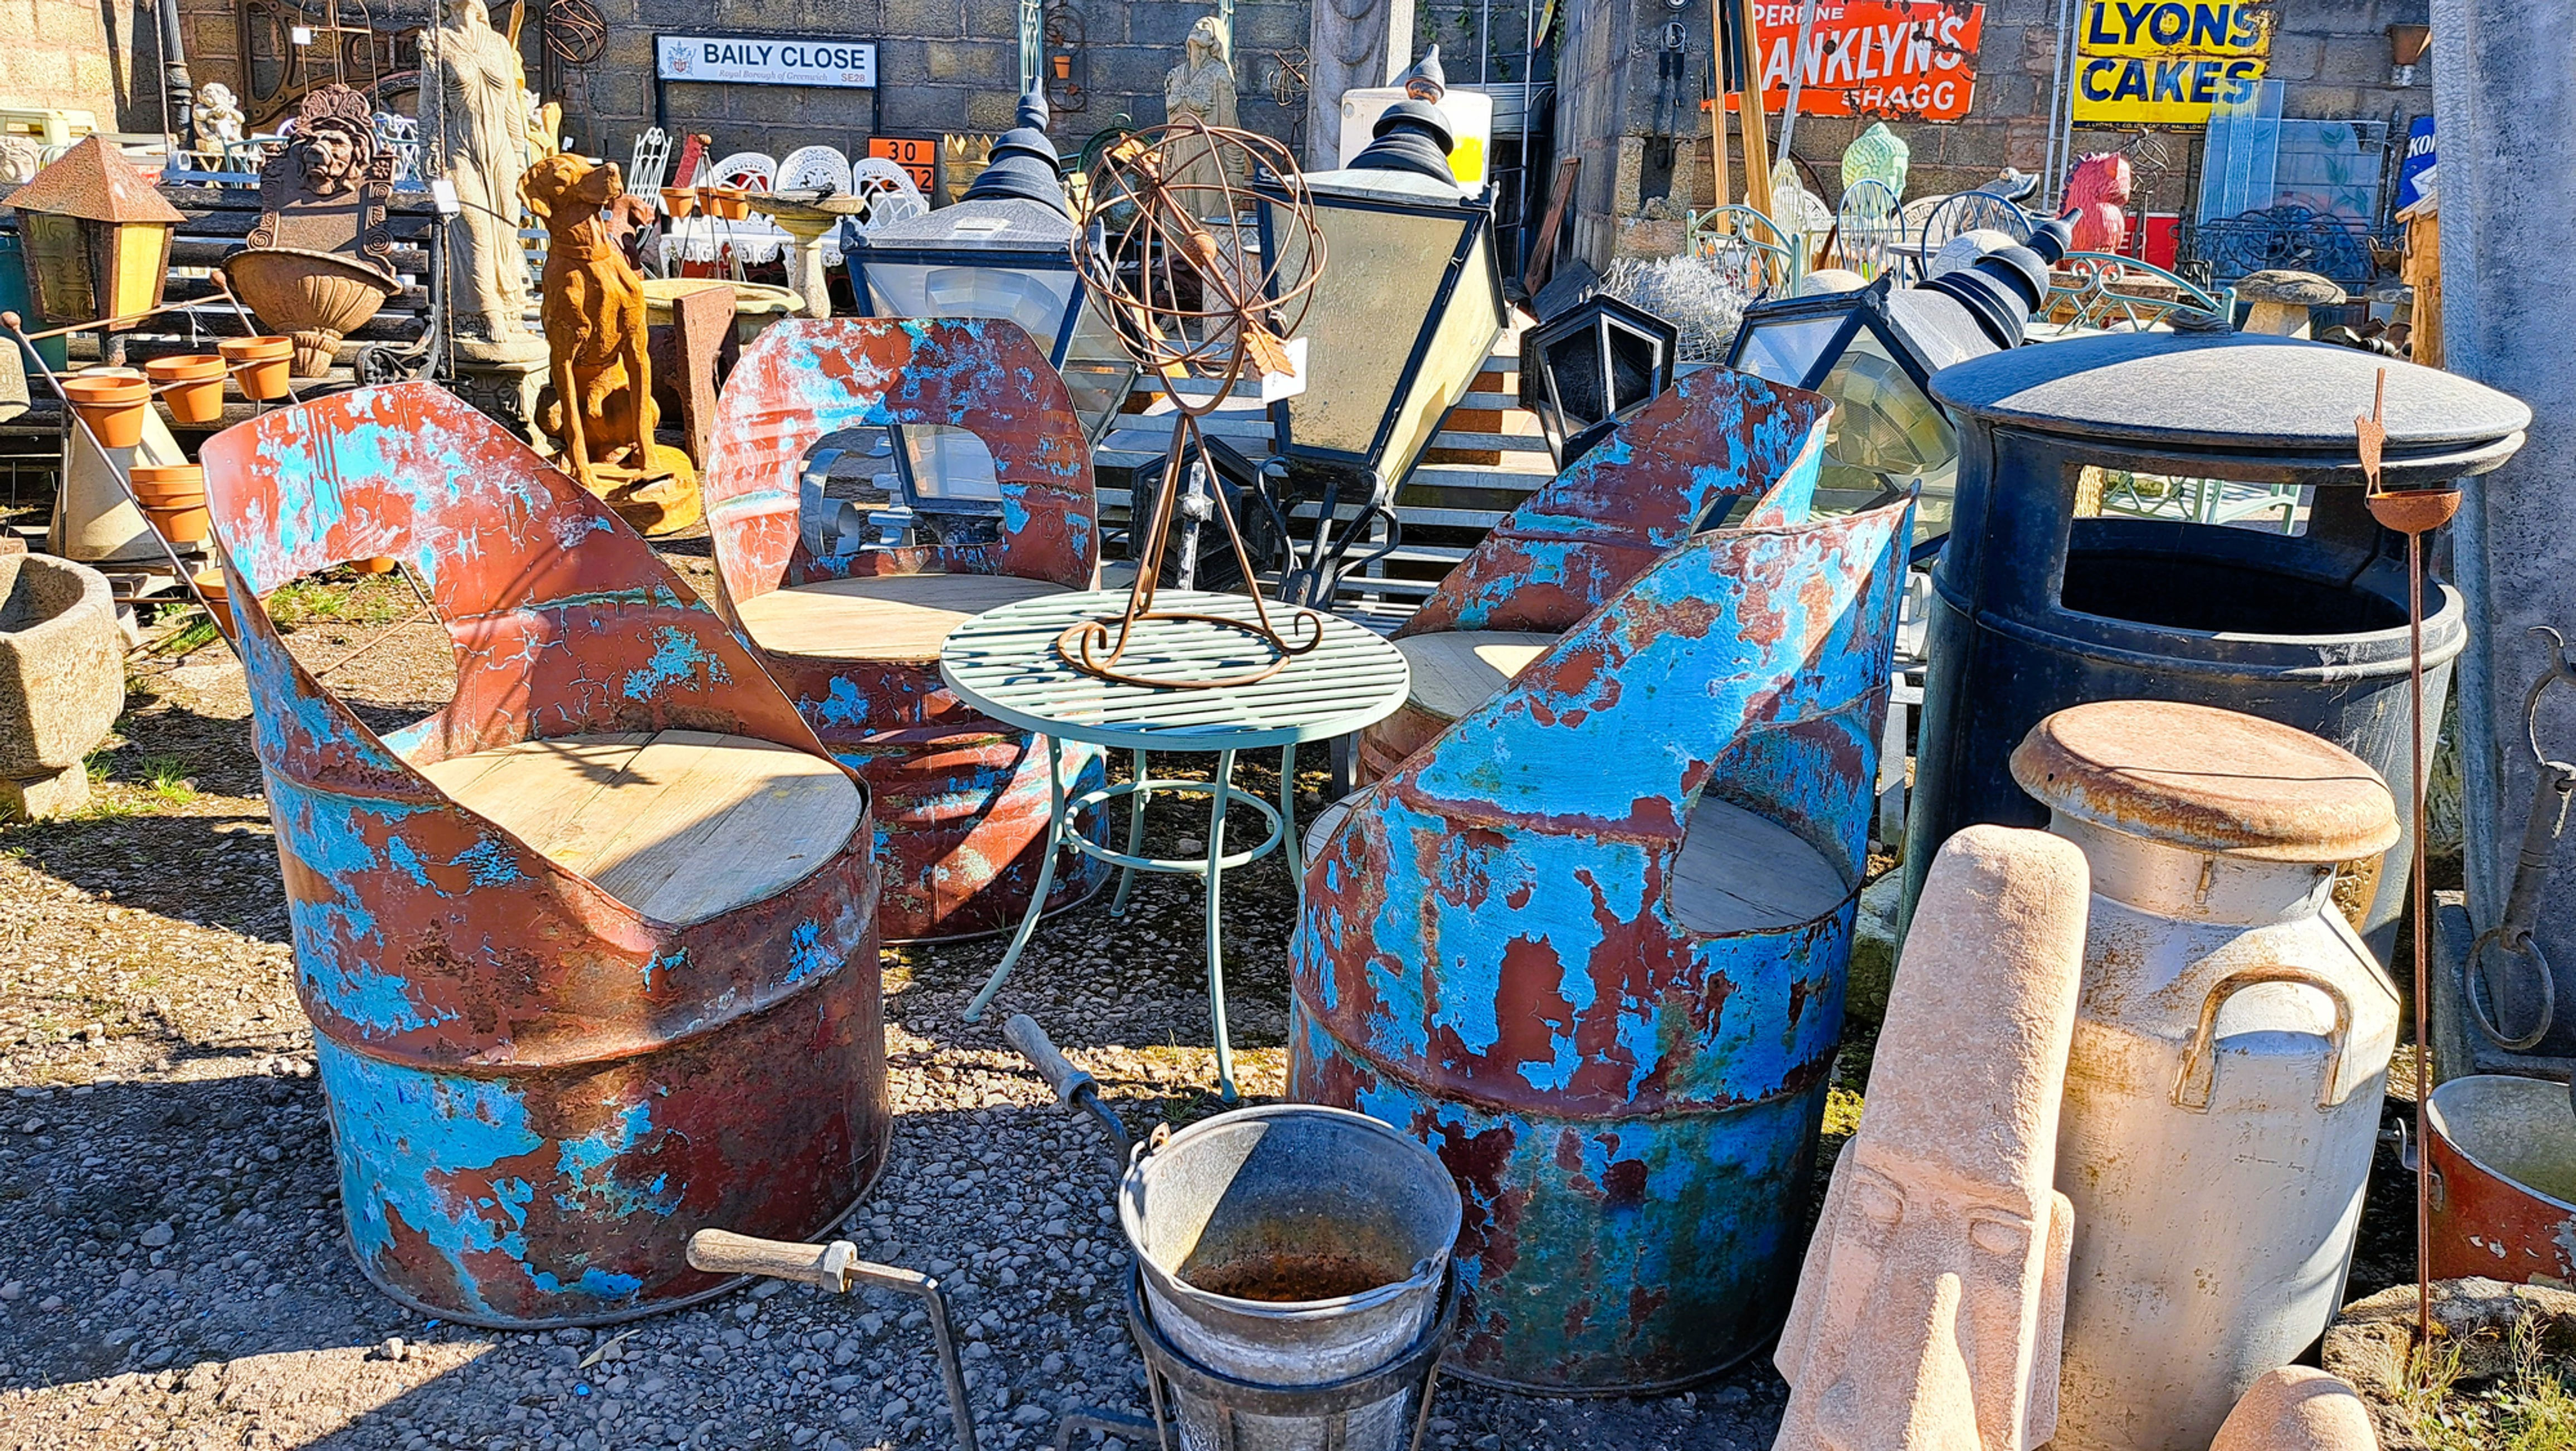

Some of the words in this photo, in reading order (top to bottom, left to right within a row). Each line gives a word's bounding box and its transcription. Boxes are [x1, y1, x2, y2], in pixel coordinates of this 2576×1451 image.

[2089, 2, 2261, 47] LYONS
[704, 43, 773, 65] BAILY
[781, 46, 865, 70] CLOSE
[1757, 11, 1965, 91] ANKLYN'S
[719, 70, 741, 79] Royal
[743, 70, 776, 80] Borough
[777, 71, 786, 80] of
[787, 72, 828, 81] Greenwich
[841, 73, 865, 82] SE28
[2081, 59, 2256, 105] CAKES
[1841, 81, 1955, 110] SHAGG
[888, 141, 916, 161] 30
